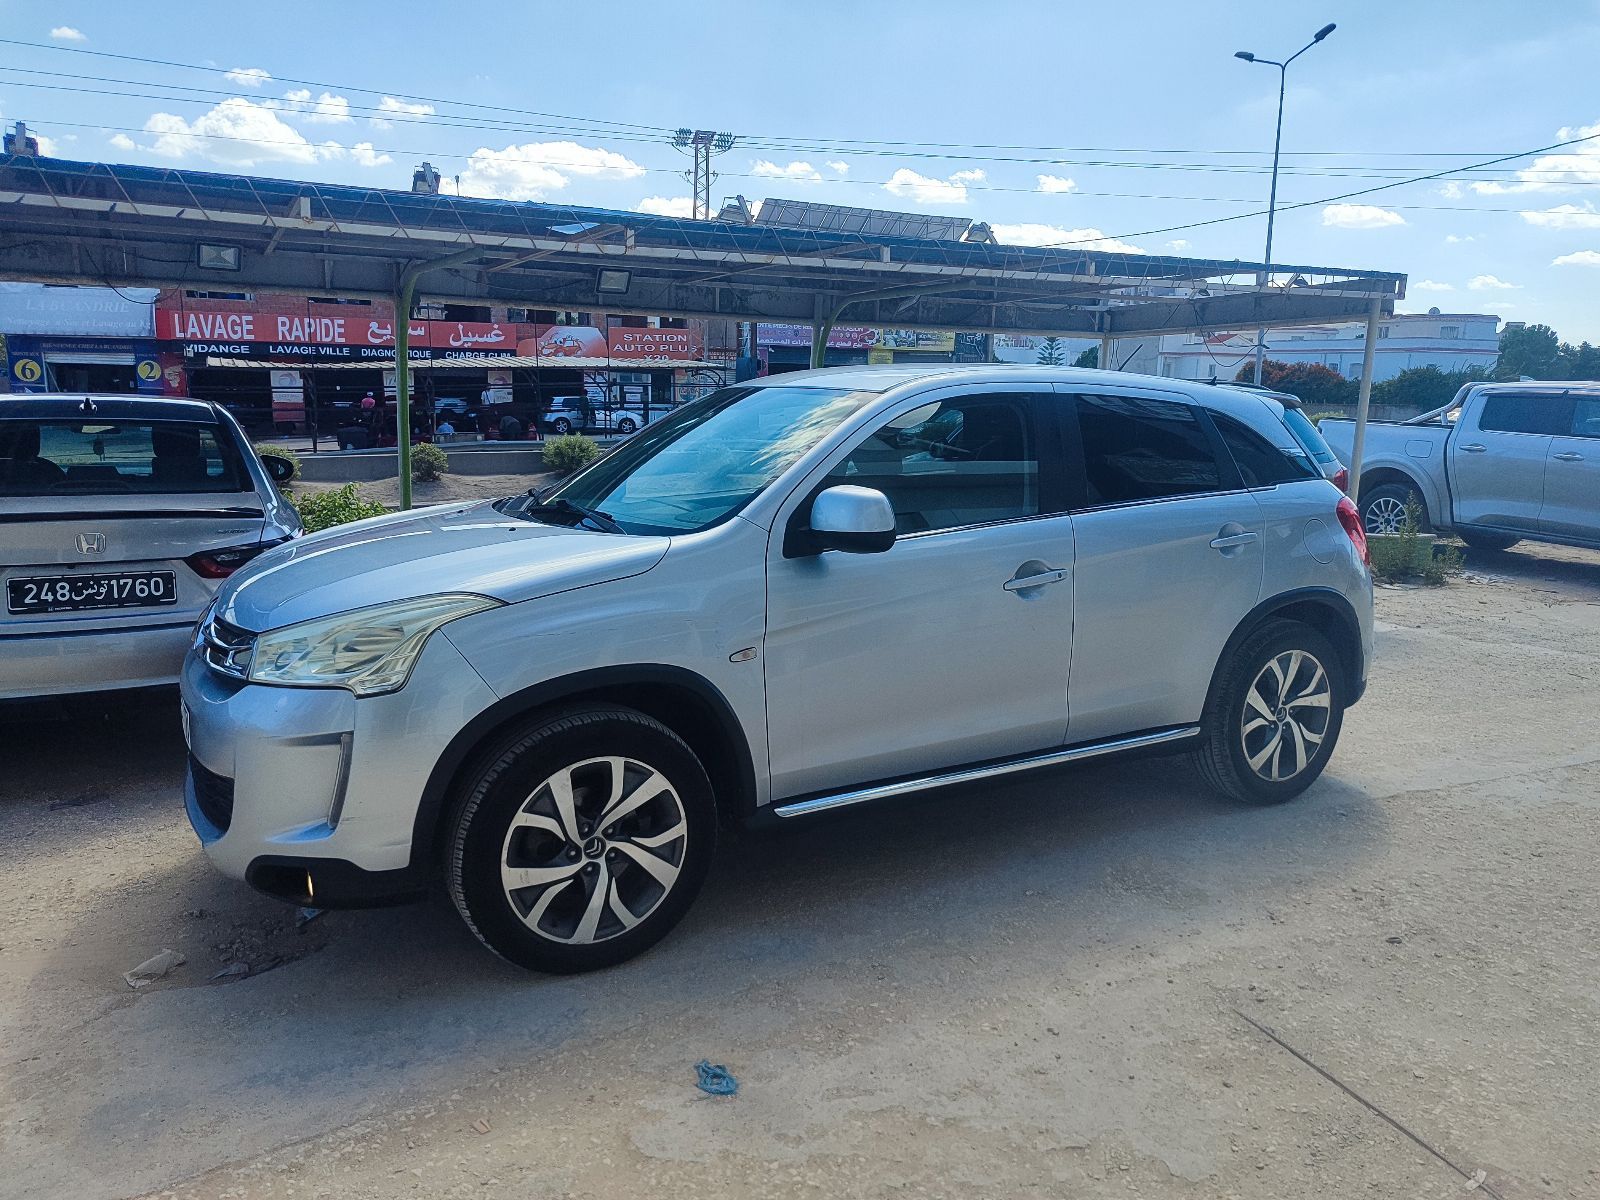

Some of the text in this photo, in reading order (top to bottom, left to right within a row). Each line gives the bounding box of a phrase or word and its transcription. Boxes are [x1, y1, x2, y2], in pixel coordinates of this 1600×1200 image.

[174, 313, 346, 343] LAVAGE RAPIDE
[367, 321, 506, 348] غسيل سيع
[623, 333, 687, 342] STATION
[185, 343, 250, 354] VIDANGE
[269, 345, 350, 356] LAVAGE VILLE
[445, 351, 486, 359] CHARGE
[613, 344, 698, 353] AUTO PLUS
[21, 360, 36, 380] 6
[142, 361, 157, 379] 2
[23, 577, 164, 604] 248 تونس 1760
